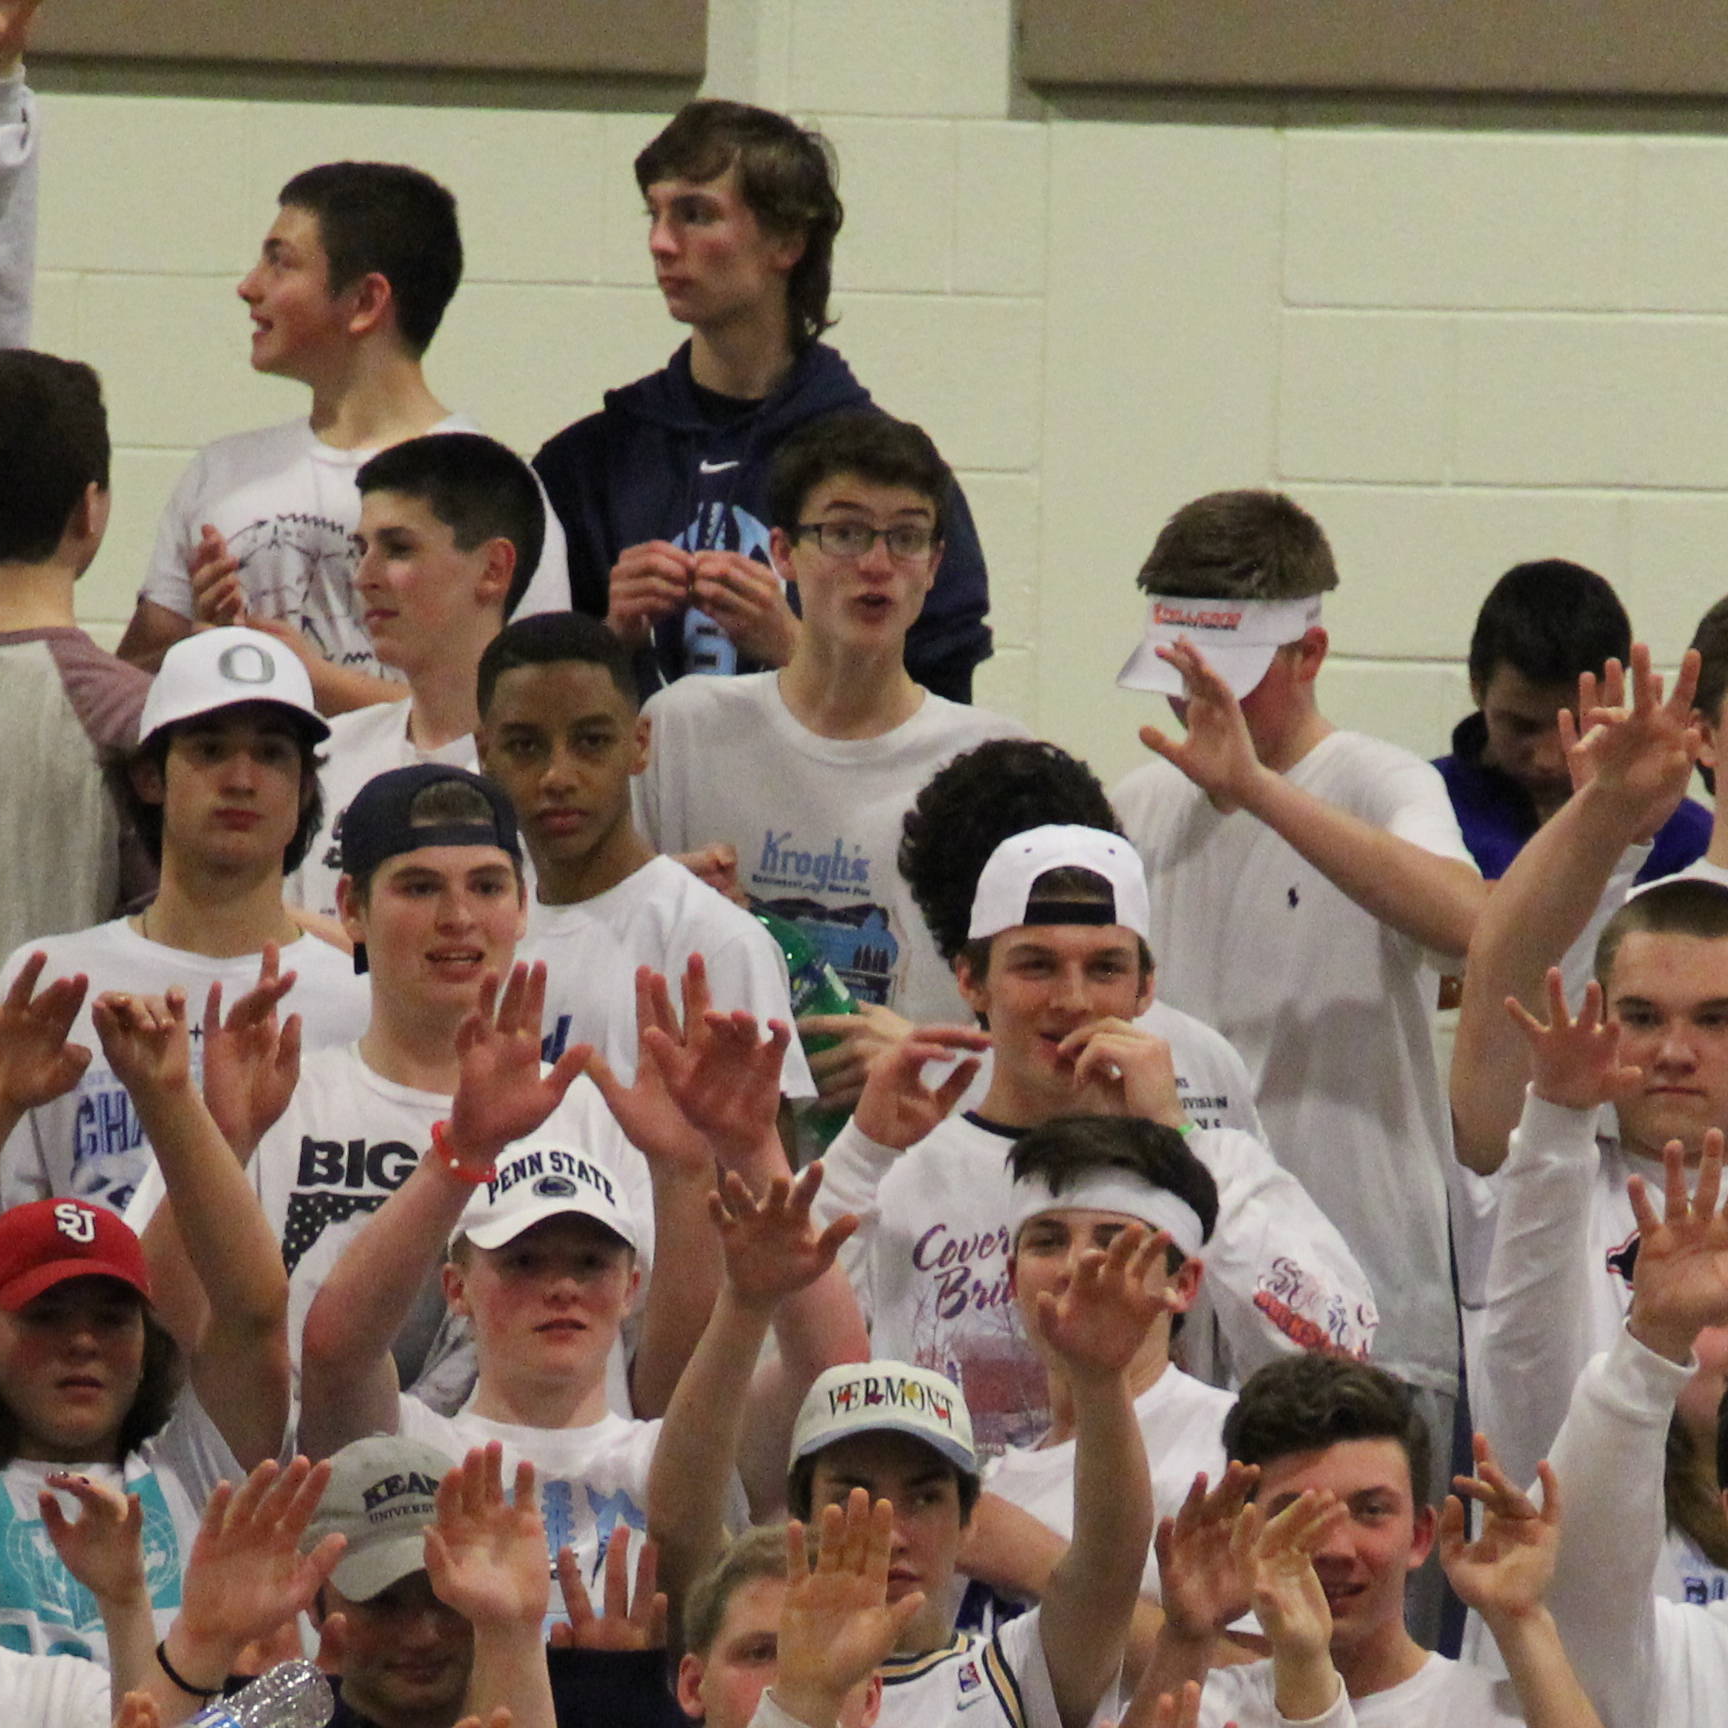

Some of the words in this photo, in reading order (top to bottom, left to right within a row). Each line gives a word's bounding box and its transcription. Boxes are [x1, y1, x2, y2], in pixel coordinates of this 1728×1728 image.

[297, 1135, 419, 1190] BIG
[488, 1155, 543, 1206] PENN
[549, 1150, 616, 1206] STATE
[828, 1375, 953, 1430] VERMONT
